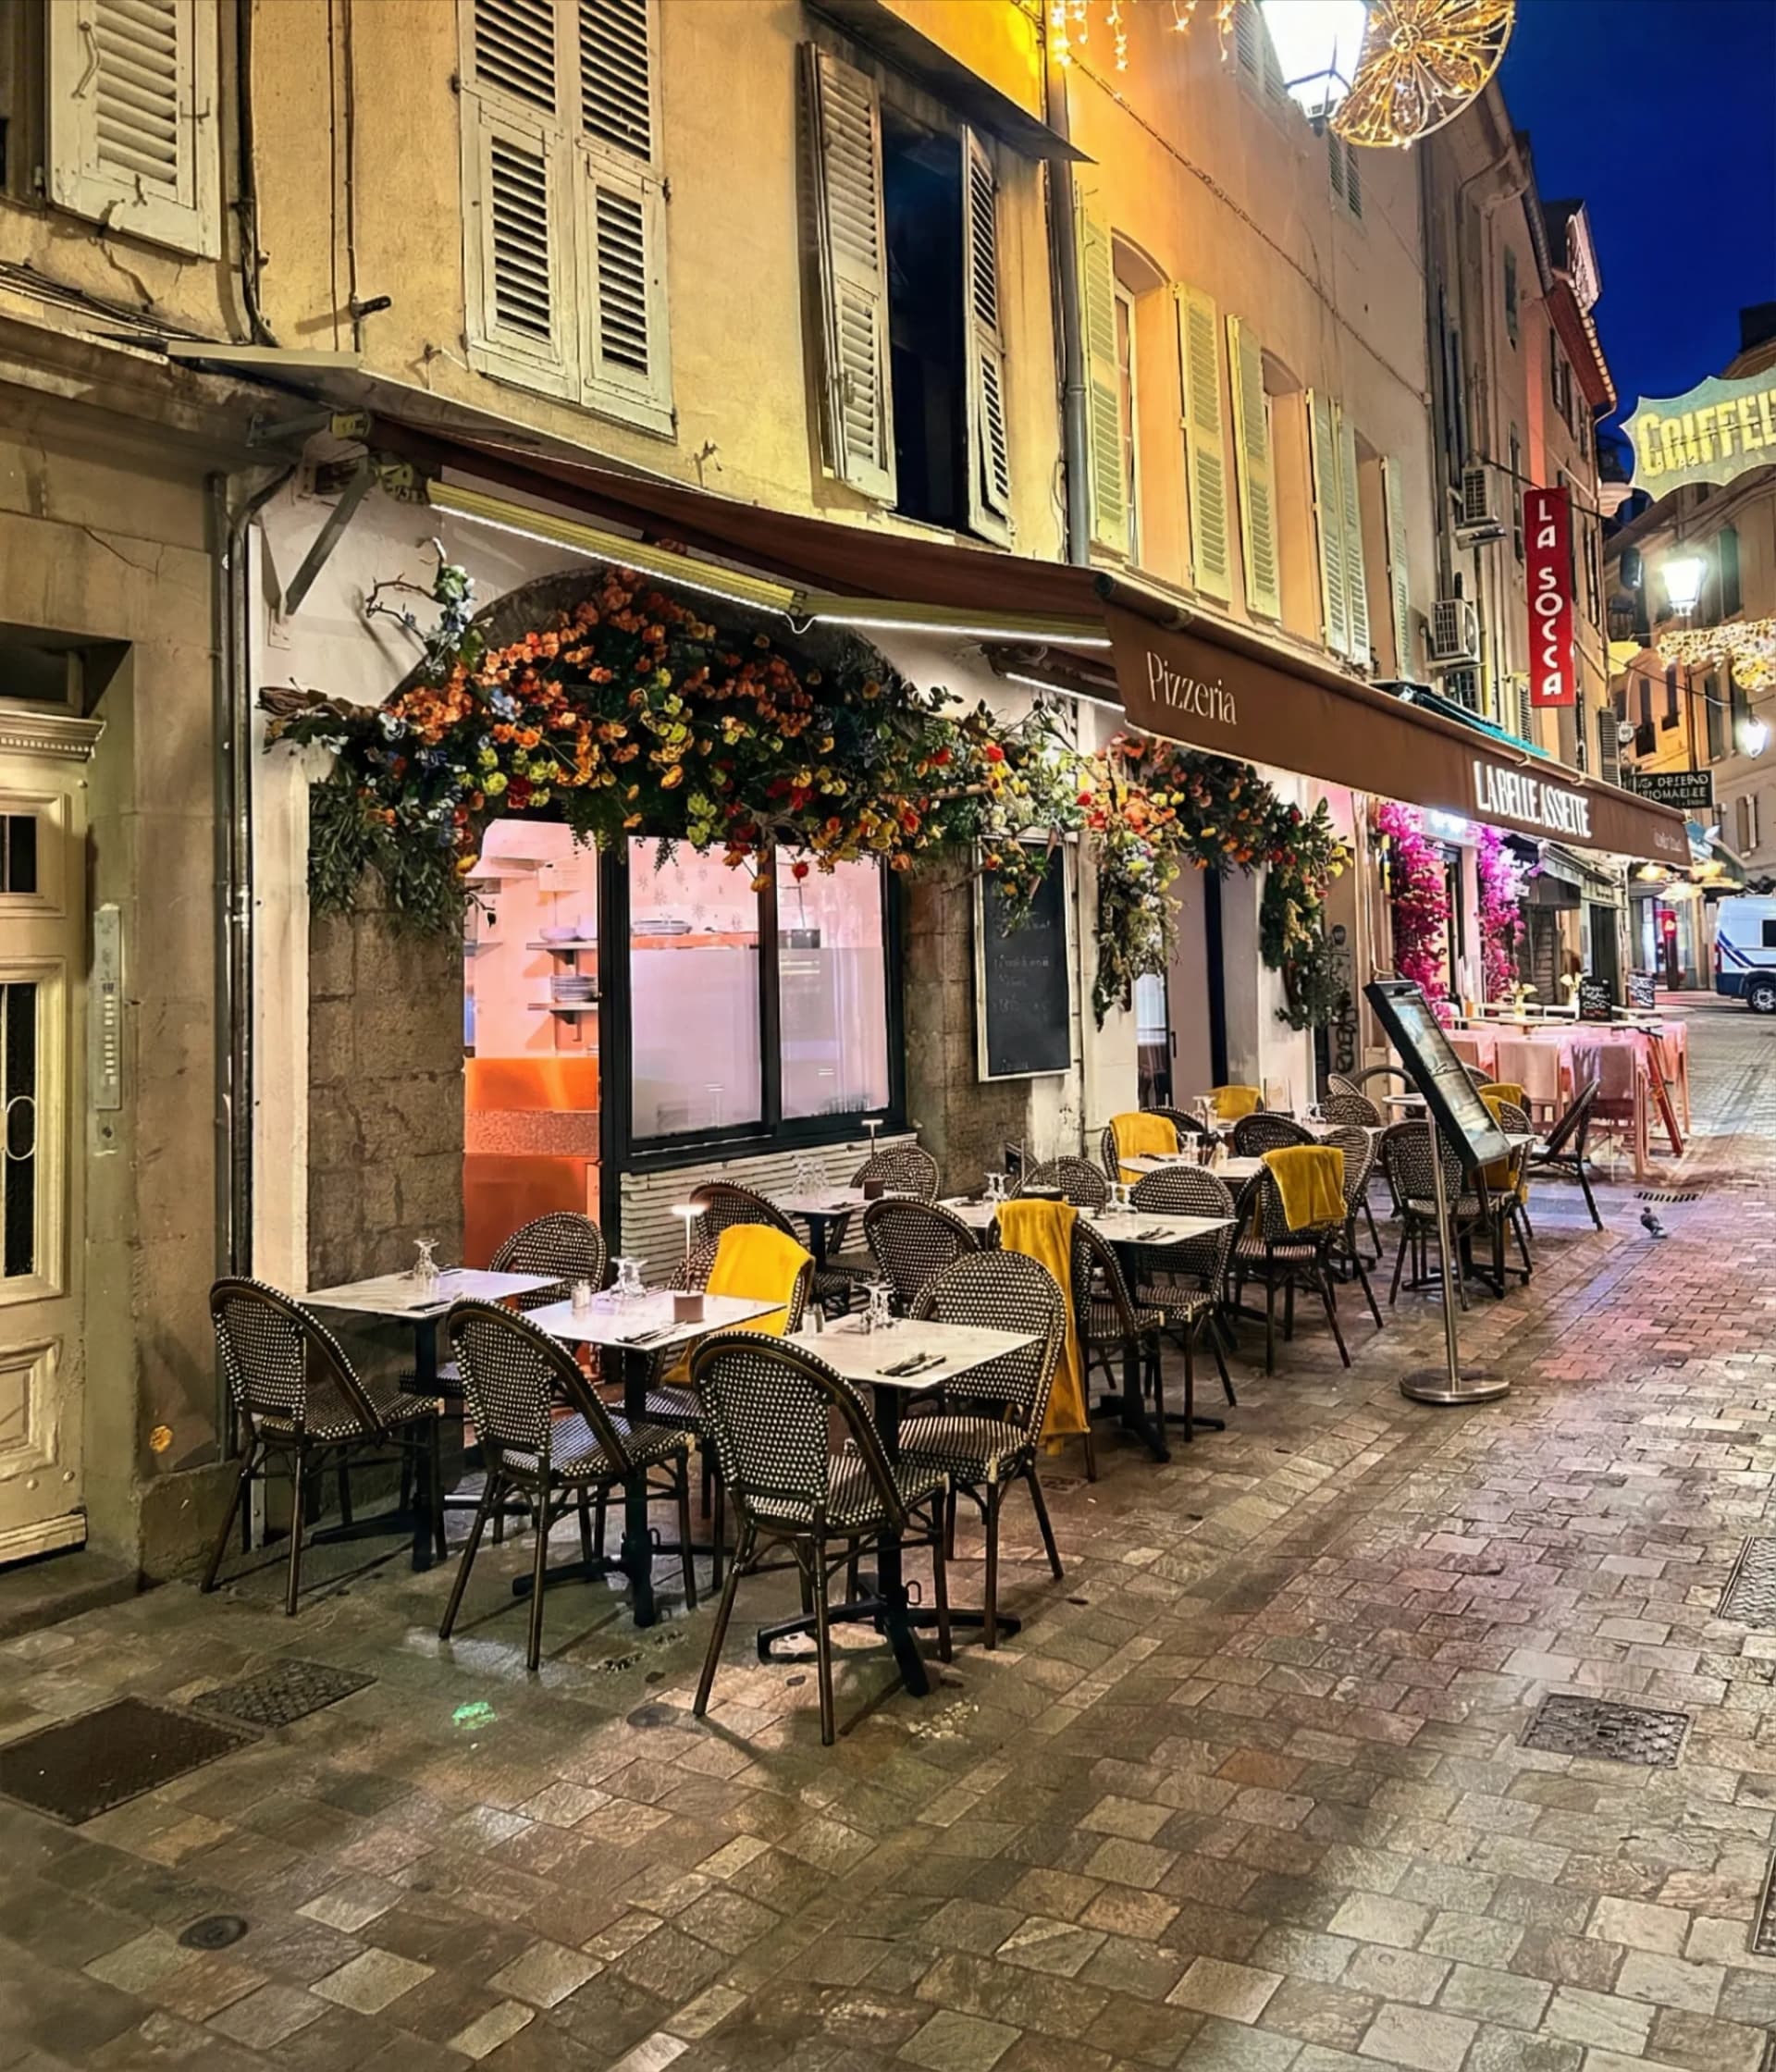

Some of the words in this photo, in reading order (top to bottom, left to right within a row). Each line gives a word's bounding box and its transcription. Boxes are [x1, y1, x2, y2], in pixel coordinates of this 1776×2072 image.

[1536, 499, 1557, 549] LA
[1535, 566, 1563, 697] SOCCA
[1146, 650, 1238, 726] Pizzeria
